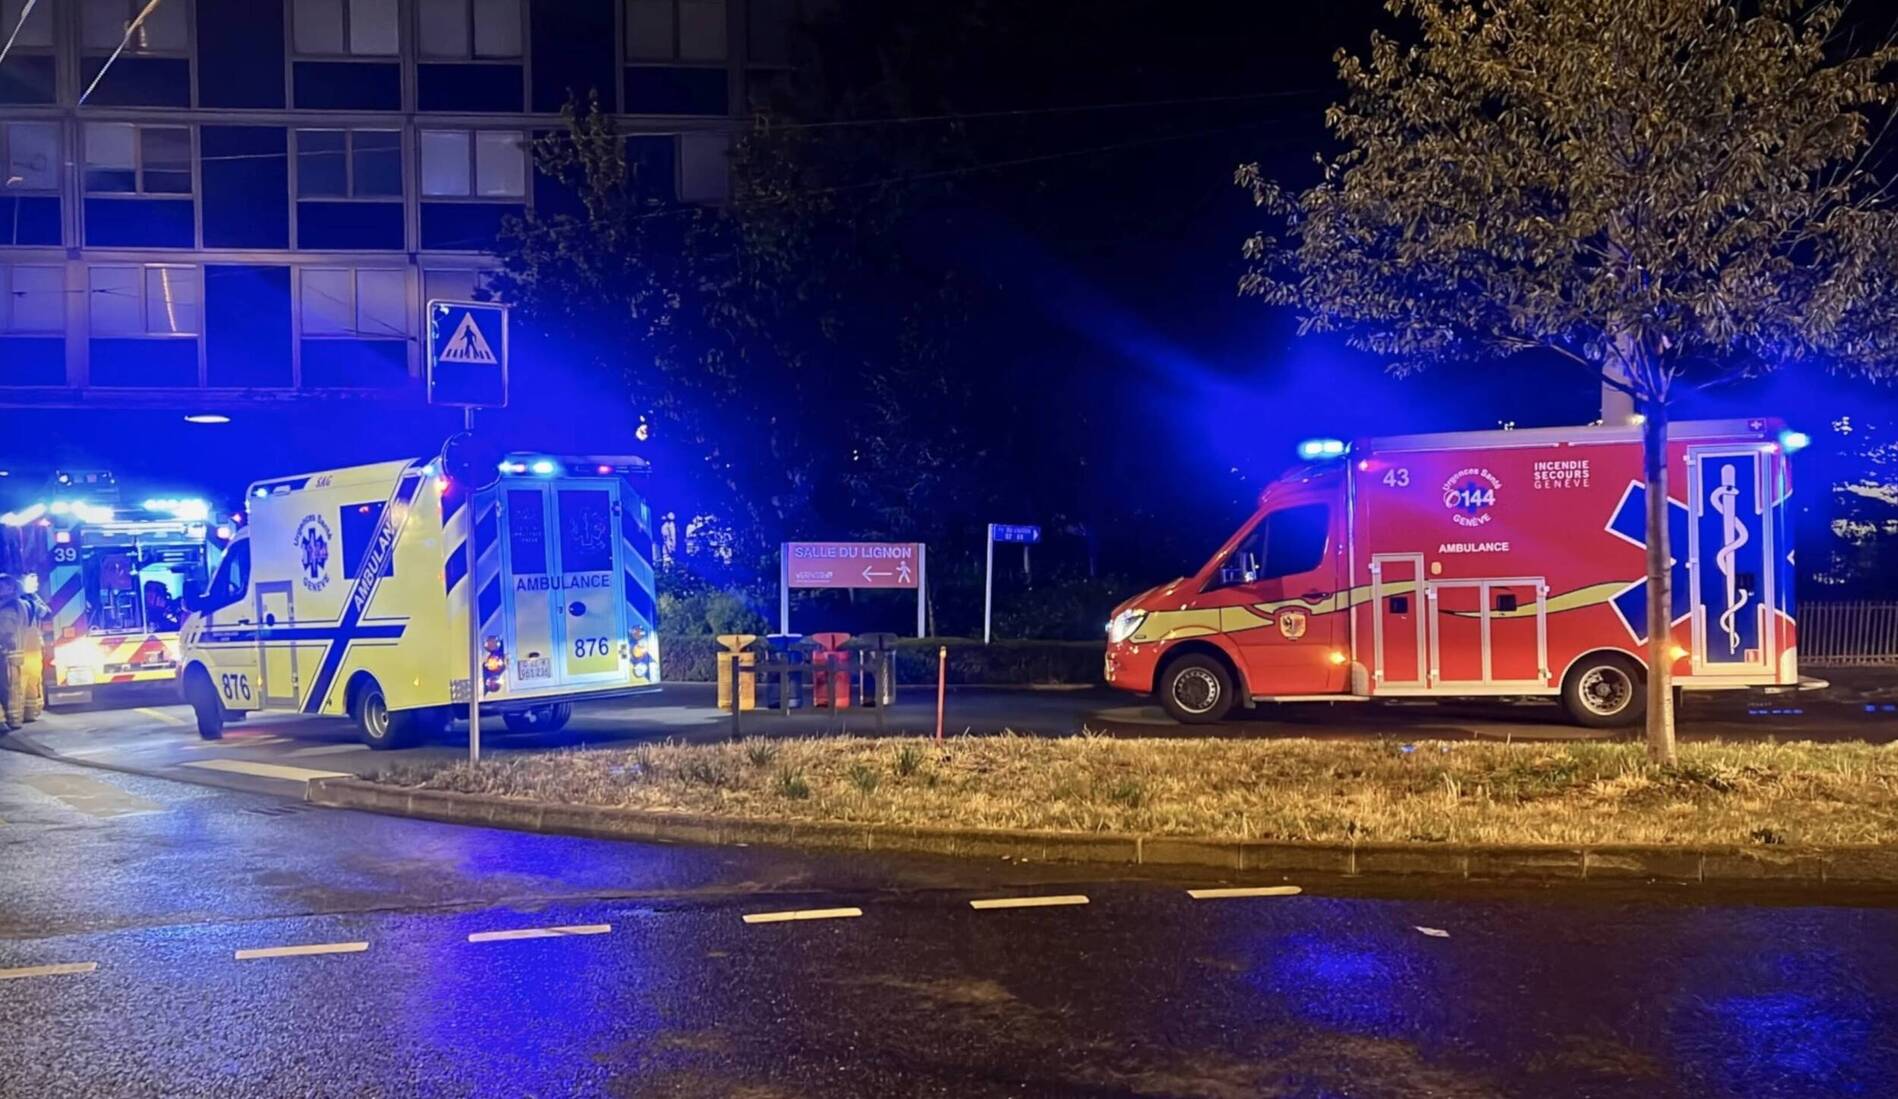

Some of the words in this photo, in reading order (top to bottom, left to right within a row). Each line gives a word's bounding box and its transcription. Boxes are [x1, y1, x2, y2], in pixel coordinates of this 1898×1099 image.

[1534, 460, 1590, 471] INCENDIE
[1383, 468, 1410, 487] 43
[1442, 468, 1479, 490] Urgences
[1480, 468, 1502, 490] Santé
[1534, 470, 1590, 480] SECOURS
[1461, 489, 1496, 507] 144
[54, 547, 77, 562] 39
[795, 546, 836, 558] SALLE
[839, 546, 858, 558] DU
[861, 546, 912, 559] LIGNON
[1438, 542, 1510, 553] AMBULANCE
[353, 515, 400, 612] AMBULAN
[516, 574, 610, 592] AMBULANCE
[575, 636, 609, 658] 876
[222, 672, 251, 701] 876
